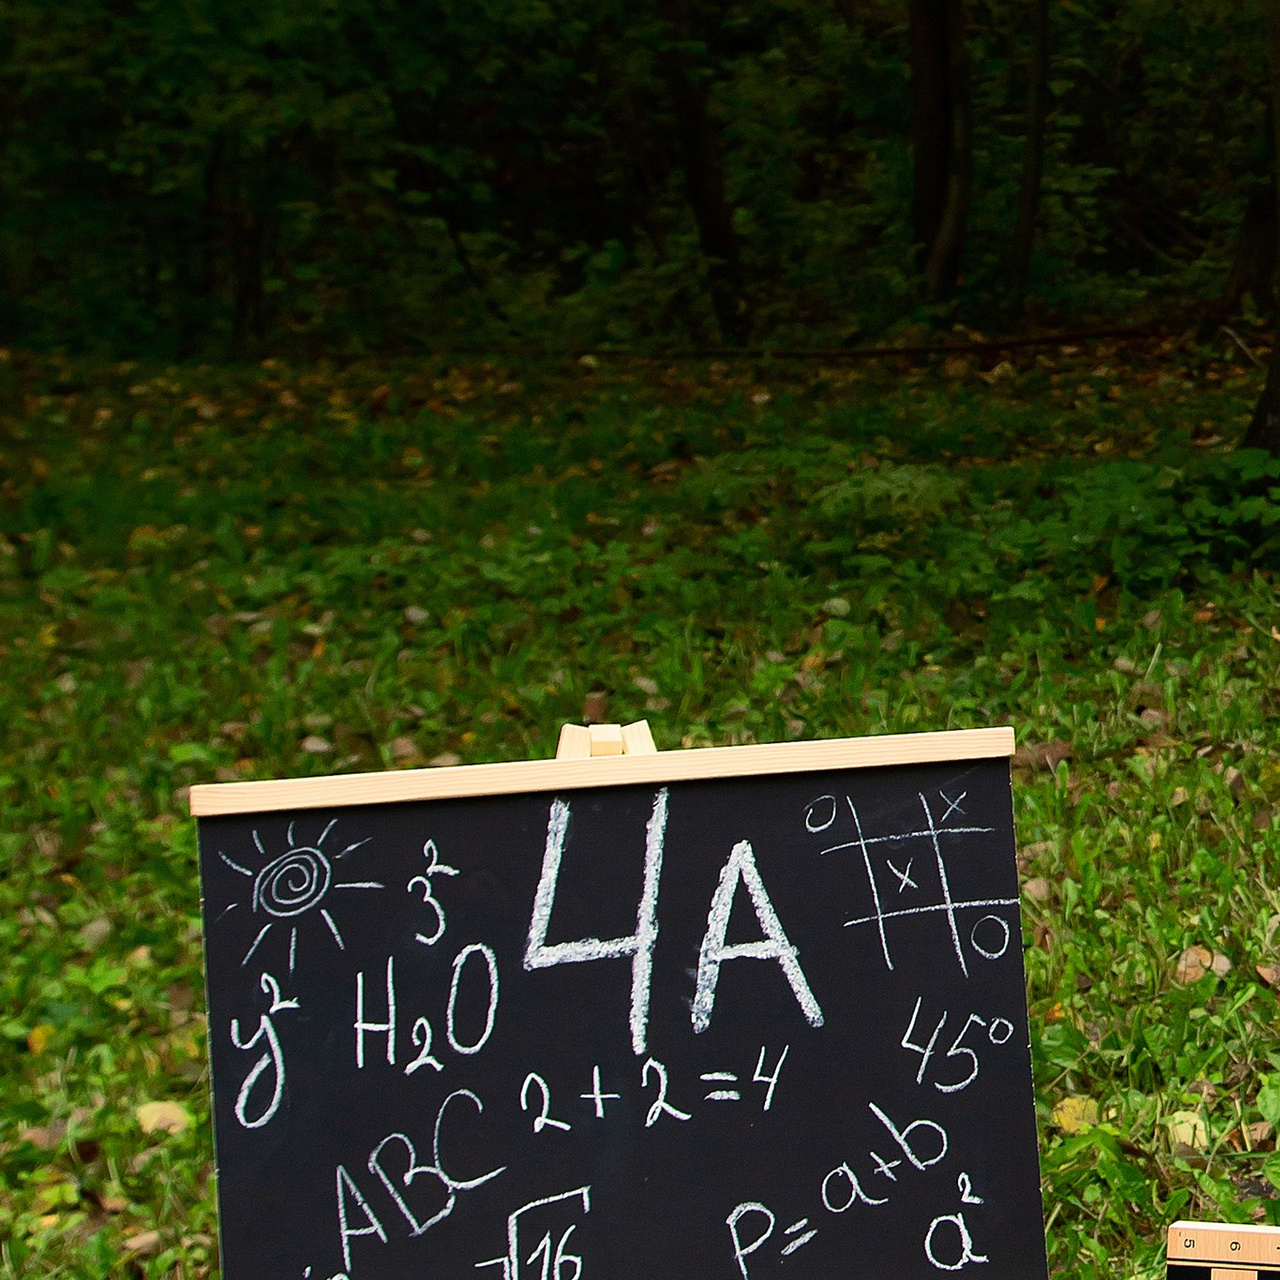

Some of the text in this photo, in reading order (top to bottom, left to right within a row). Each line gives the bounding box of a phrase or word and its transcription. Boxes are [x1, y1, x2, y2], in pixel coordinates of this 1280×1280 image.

[522, 786, 826, 1056] 4A
[336, 1088, 508, 1274] ABC
[1183, 1238, 1195, 1249] 5
[1229, 1241, 1241, 1251] 6
